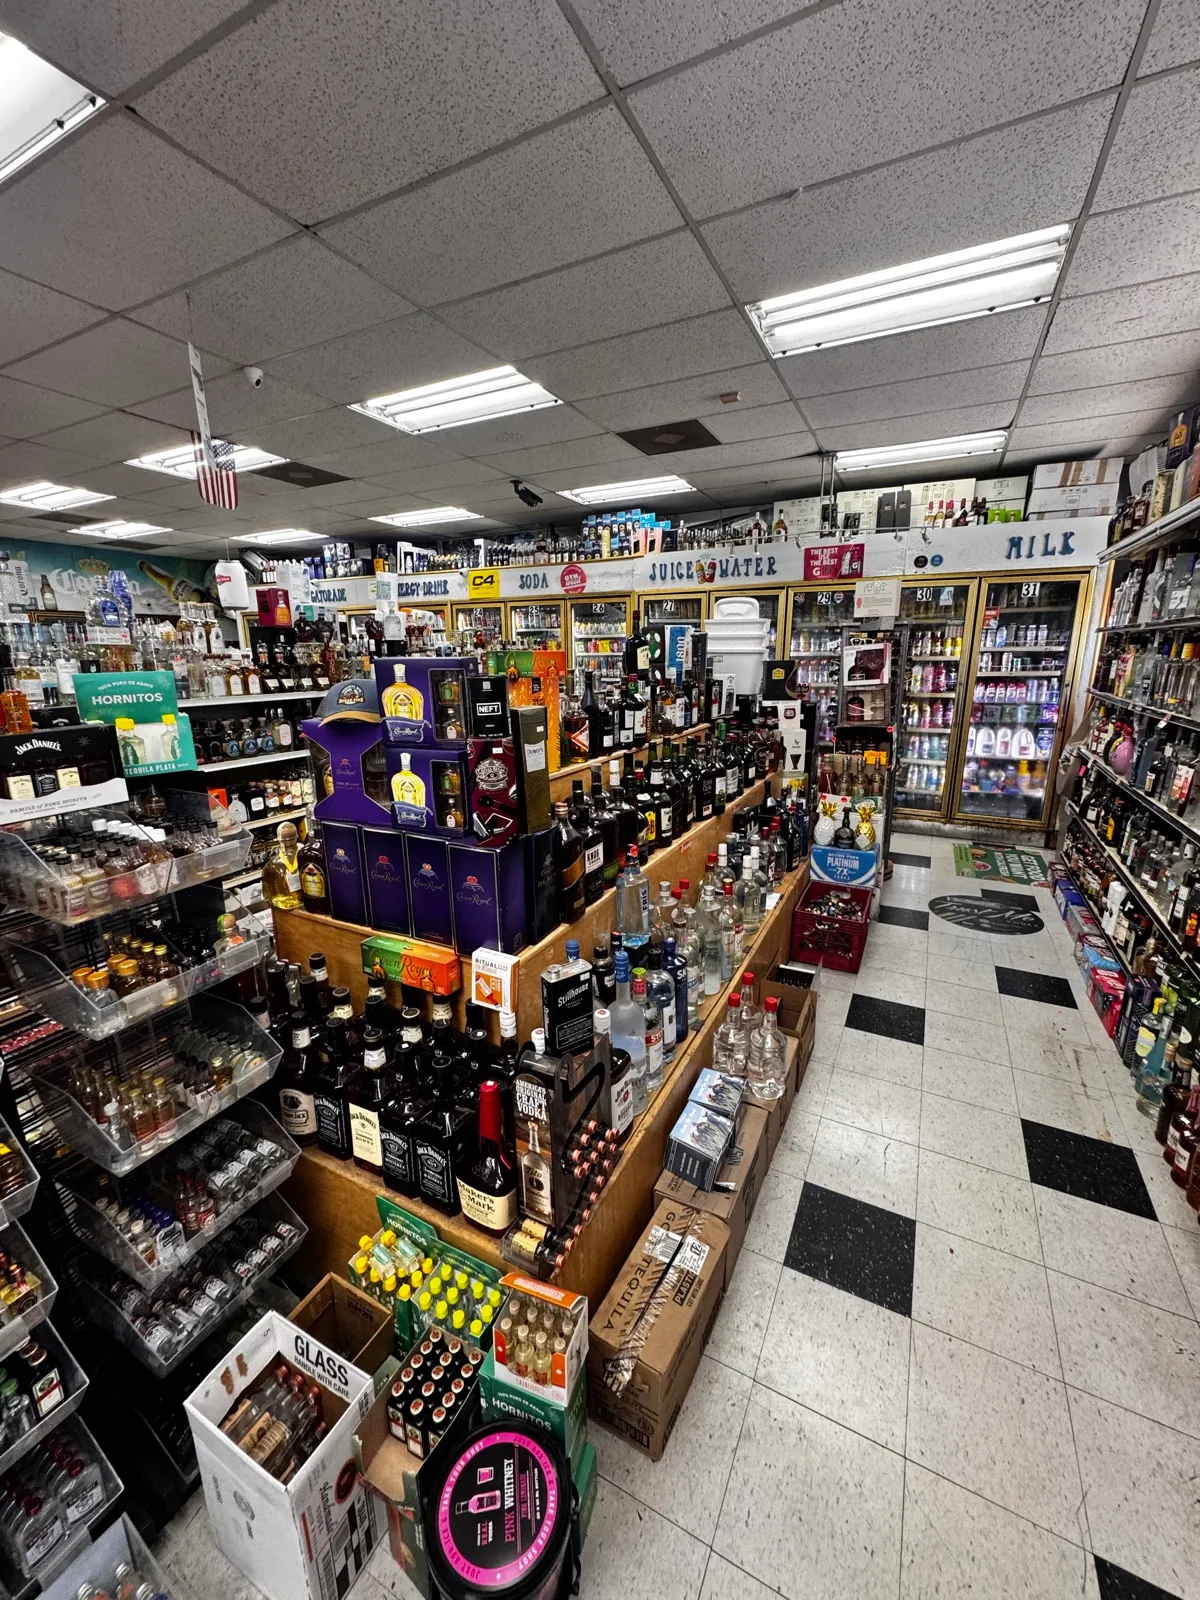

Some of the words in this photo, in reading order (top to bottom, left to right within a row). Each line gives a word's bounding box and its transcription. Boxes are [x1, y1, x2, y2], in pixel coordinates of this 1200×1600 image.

[1005, 531, 1075, 560] MILK
[649, 561, 694, 581] JUICE
[719, 556, 777, 578] WATER
[423, 580, 450, 597] DRINK
[472, 575, 495, 587] C4
[518, 572, 549, 590] SODA
[311, 588, 347, 603] GATORADE
[818, 592, 831, 604] 29
[917, 588, 932, 600] 30
[1022, 583, 1037, 597] 31
[529, 605, 539, 615] 25
[593, 604, 604, 613] 26
[664, 601, 674, 611] 27
[675, 637, 685, 662] 1800
[92, 693, 163, 705] HORNITOS
[479, 705, 498, 713] NEFT
[15, 740, 35, 755] JACK
[32, 739, 61, 751] DANIEL'S
[124, 766, 154, 776] TEQUILA
[156, 764, 176, 773] PLATA
[827, 857, 860, 869] PLATINUM
[836, 868, 848, 876] 7X
[475, 958, 497, 970] RITUAL
[557, 983, 589, 1008] Stillhouse
[515, 1079, 546, 1095] AMERICA'S
[516, 1085, 546, 1101] ORIGINAL
[516, 1093, 547, 1111] CRAFT
[517, 1101, 547, 1121] VODKA
[458, 1182, 495, 1205] Maker's
[467, 1193, 496, 1212] Mark
[386, 1216, 428, 1246] HORNITOS
[602, 1256, 653, 1331] TEQUILA
[294, 1334, 349, 1387] GLASS
[294, 1355, 316, 1378] HANDLE
[316, 1372, 333, 1388] WITH
[333, 1382, 350, 1399] CARE
[492, 1397, 552, 1432] HORNITOS
[503, 1458, 515, 1511] WHITNEY
[504, 1511, 515, 1543] PINK
